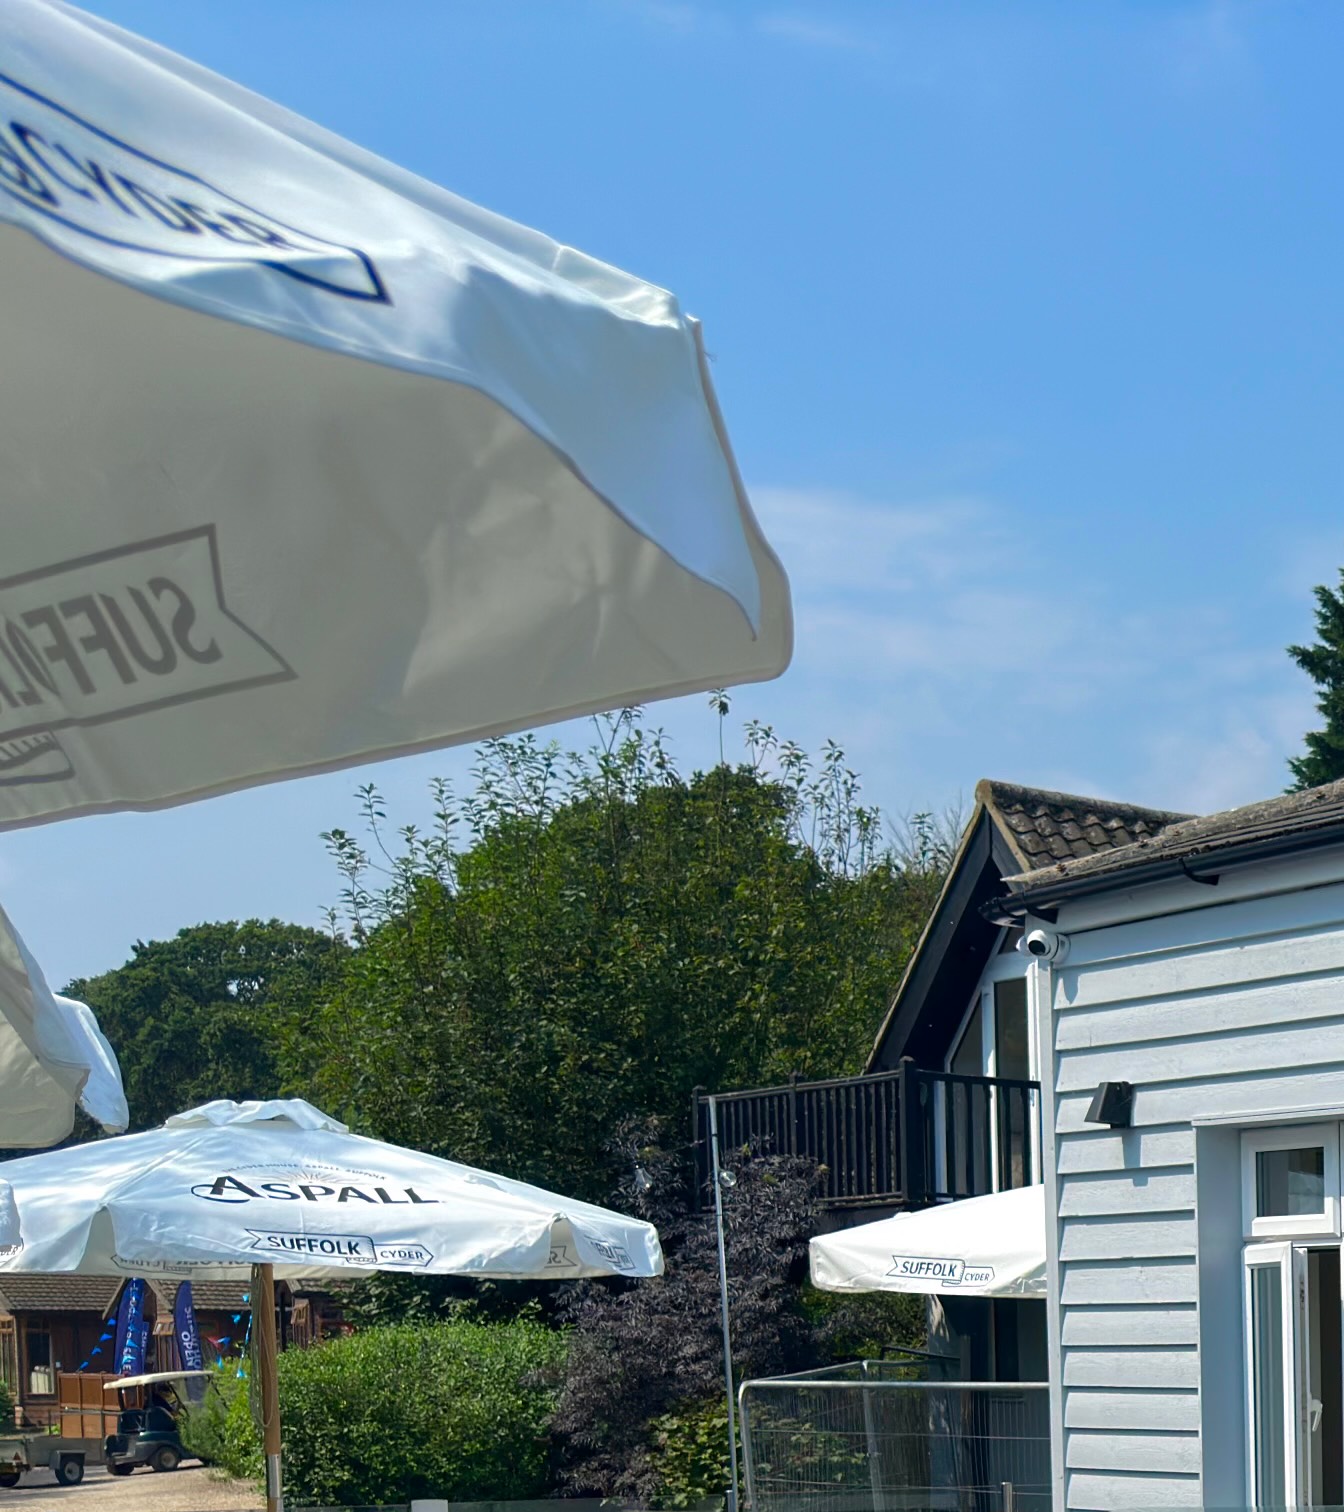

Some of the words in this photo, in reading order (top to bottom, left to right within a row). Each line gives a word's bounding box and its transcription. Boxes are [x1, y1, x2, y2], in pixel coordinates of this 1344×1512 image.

[191, 1175, 440, 1204] ASPALL
[267, 1235, 361, 1256] SUFFOLK
[380, 1249, 424, 1261] CYDER
[900, 1261, 957, 1278] SUFFOLK
[964, 1272, 990, 1282] CYDER
